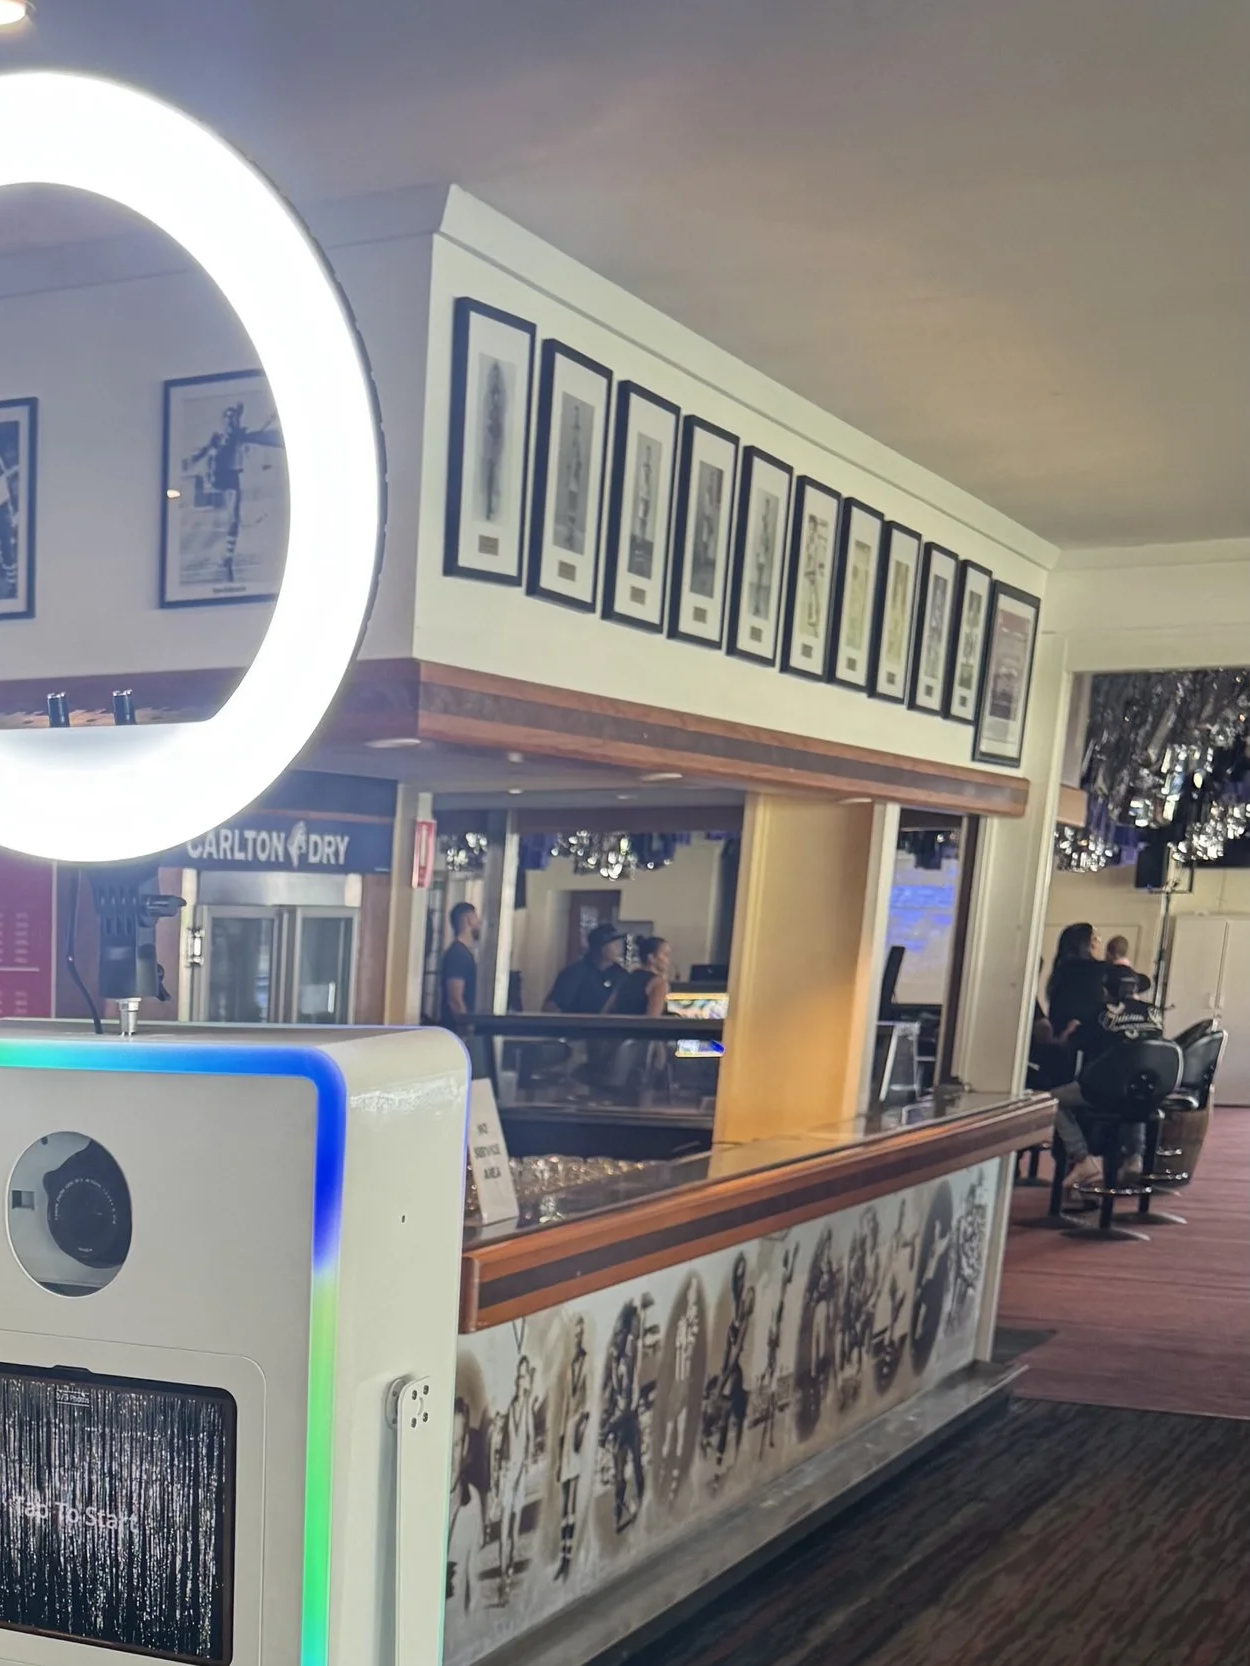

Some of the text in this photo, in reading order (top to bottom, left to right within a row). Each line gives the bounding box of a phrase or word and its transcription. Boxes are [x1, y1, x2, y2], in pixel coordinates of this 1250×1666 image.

[308, 835, 349, 864] DRY
[11, 1495, 139, 1533] Tap To Start
